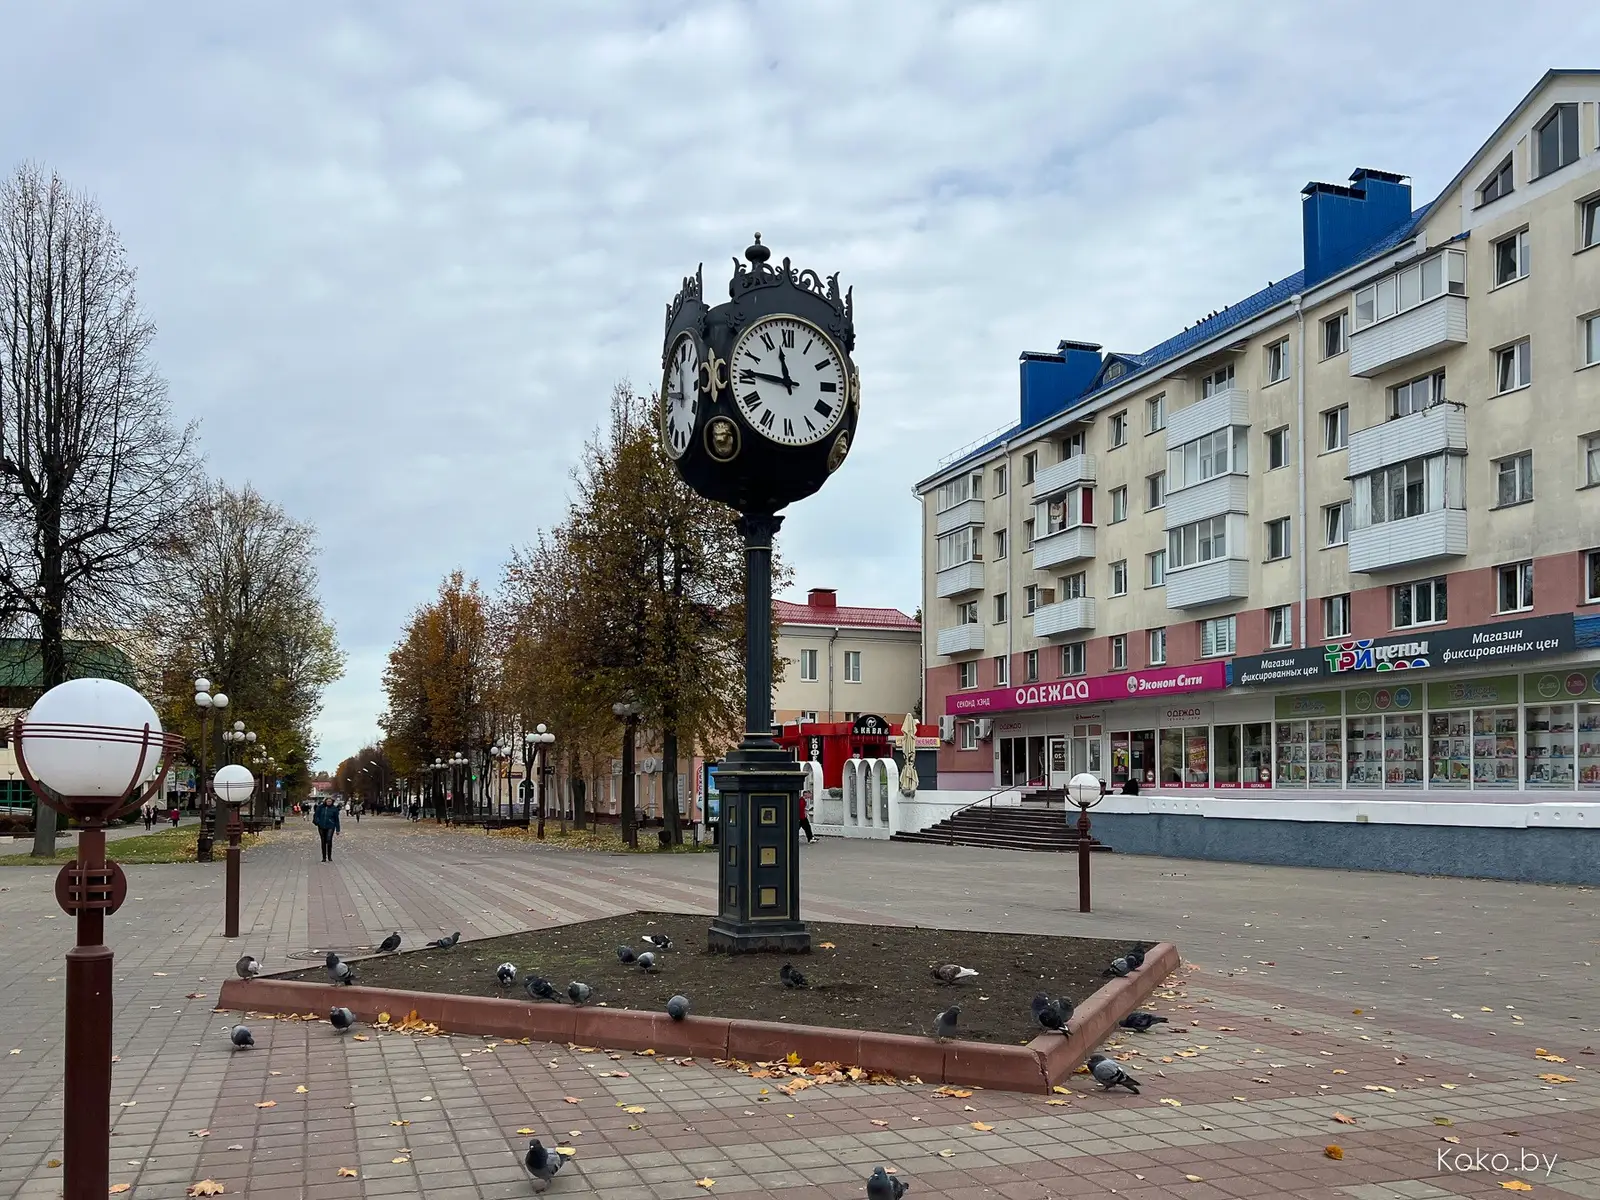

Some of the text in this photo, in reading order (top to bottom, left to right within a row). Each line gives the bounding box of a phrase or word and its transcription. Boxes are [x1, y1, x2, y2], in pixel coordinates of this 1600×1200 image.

[1472, 628, 1523, 644] Магазин
[1324, 640, 1430, 673] ТРИ цены
[1442, 638, 1559, 664] фиксированных цен
[1260, 658, 1295, 670] Магазин
[1138, 674, 1203, 691] Эконом Сити
[1241, 666, 1319, 685] фиксированных цен
[1015, 680, 1089, 705] ОДЕЖДА
[956, 697, 991, 709] СЕКОНД ХЭНД
[1166, 708, 1201, 717] ОДЕЖДА
